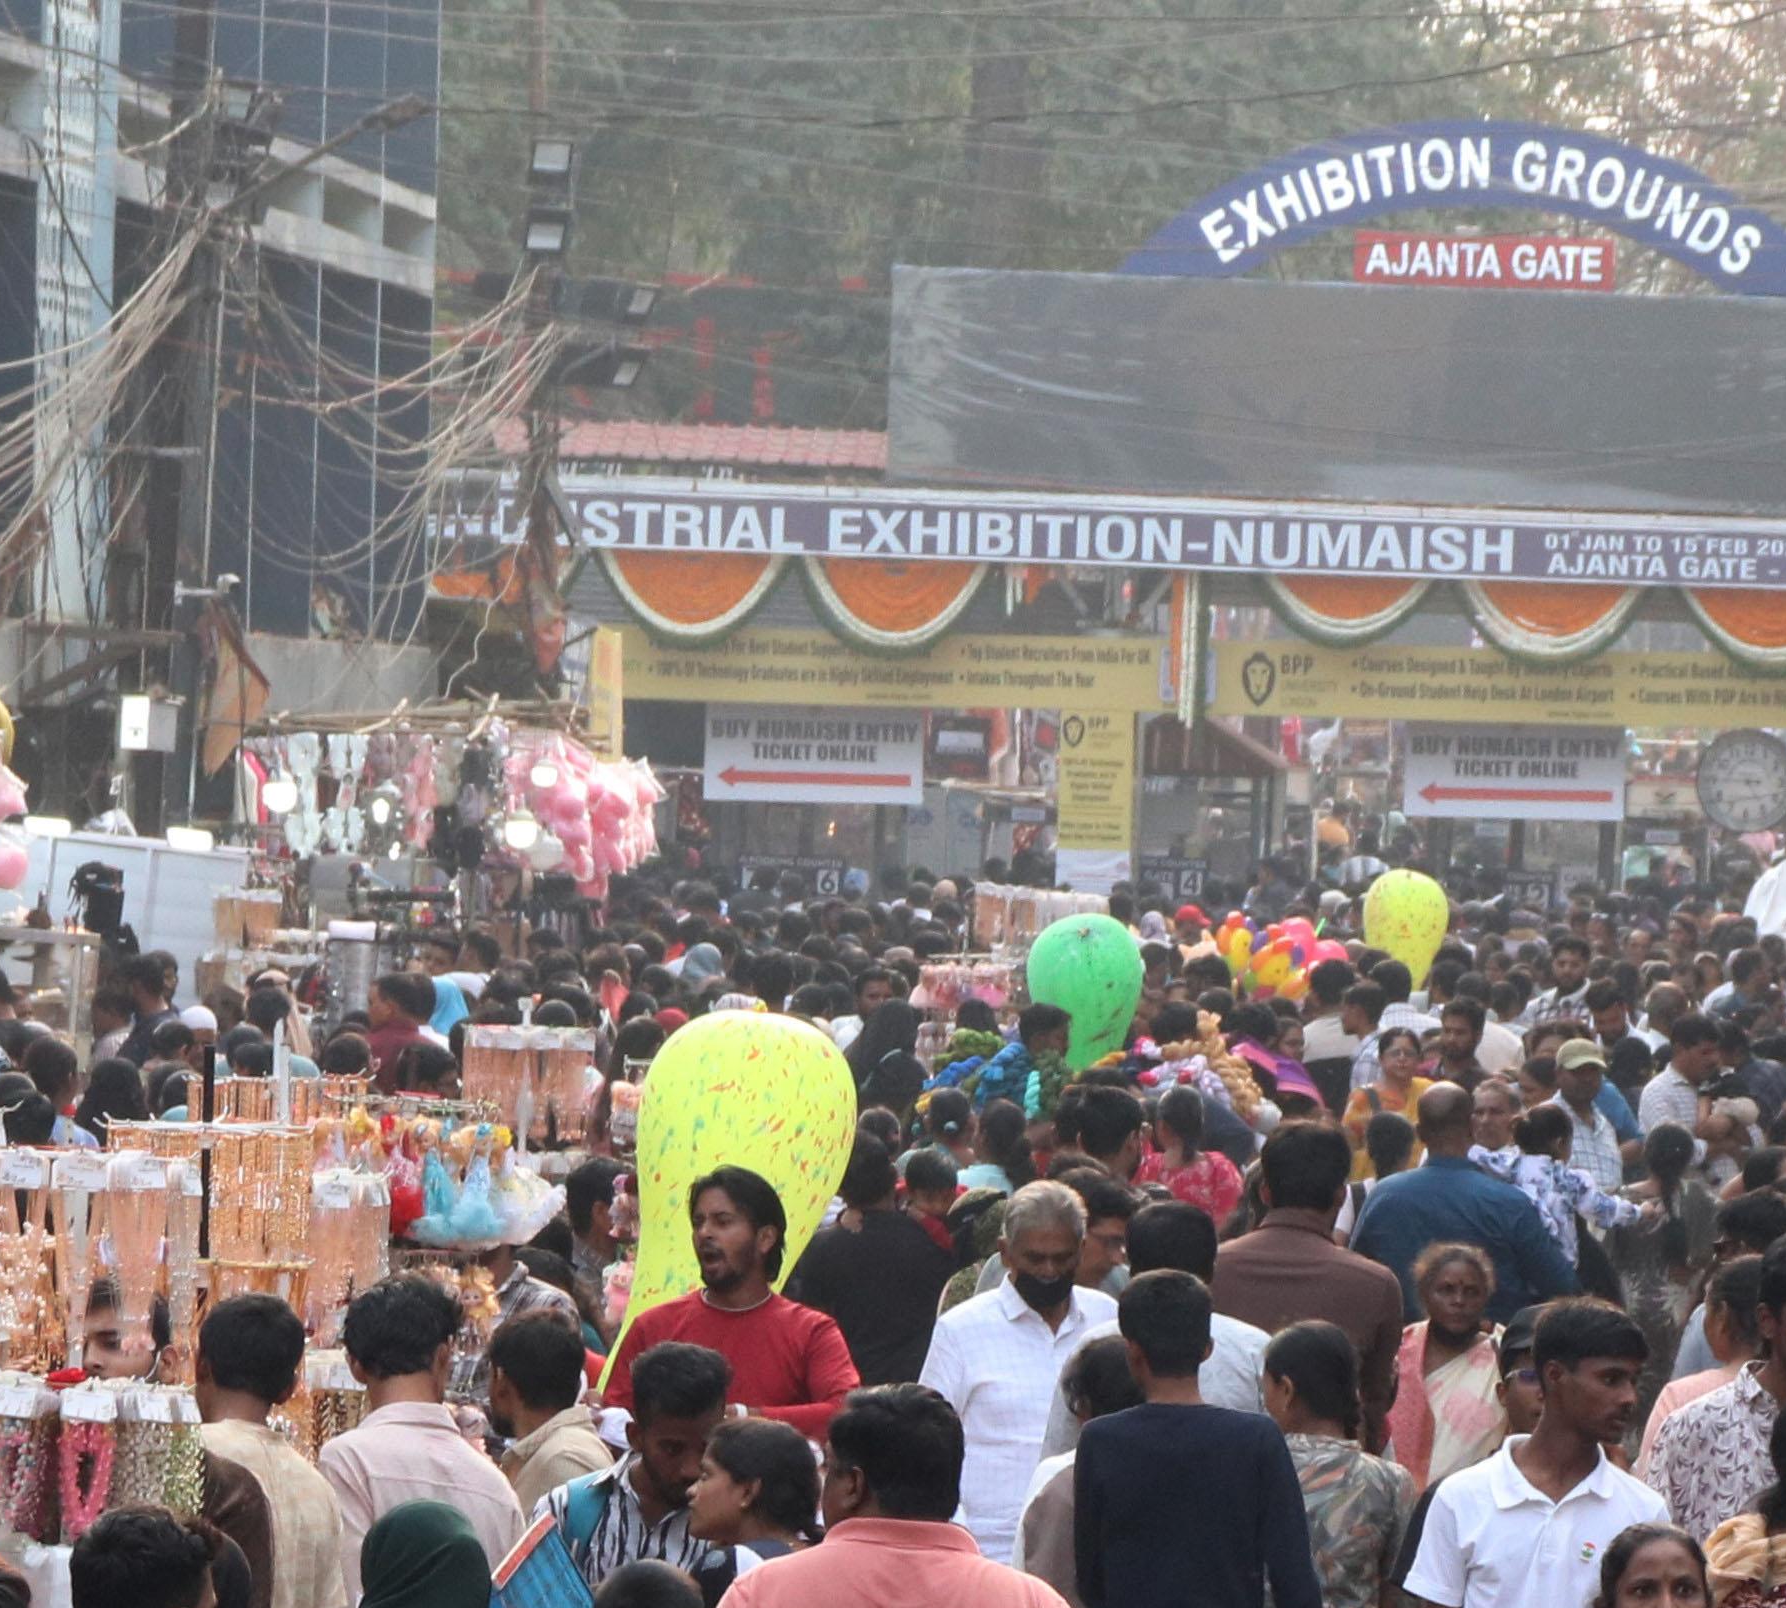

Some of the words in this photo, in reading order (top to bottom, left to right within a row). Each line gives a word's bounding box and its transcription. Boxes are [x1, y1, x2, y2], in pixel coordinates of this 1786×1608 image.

[1199, 137, 1492, 263] EXHIBITION
[1512, 140, 1762, 275] GROUNDS
[1365, 242, 1503, 280] AJANTA
[1510, 245, 1603, 283] GATE
[827, 507, 1514, 572] EXHIBITION-NUMAISH
[1579, 533, 1626, 553] JAN
[1632, 535, 1662, 553] TO
[1706, 538, 1749, 556] FEB
[1546, 553, 1668, 577] AJANTA
[1677, 556, 1758, 580] GATE
[1280, 654, 1314, 674] BPP
[710, 719, 751, 739] BUY
[756, 720, 851, 742] NUMAISH
[853, 721, 919, 744] ENTRY
[751, 742, 813, 762] TICKET
[817, 743, 878, 763] ONLINE
[1413, 735, 1452, 756] BUY
[1457, 736, 1552, 759] NUMAISH
[1553, 738, 1616, 760] ENTRY
[1452, 759, 1512, 778] TICKET
[1517, 760, 1580, 780] ONLINE
